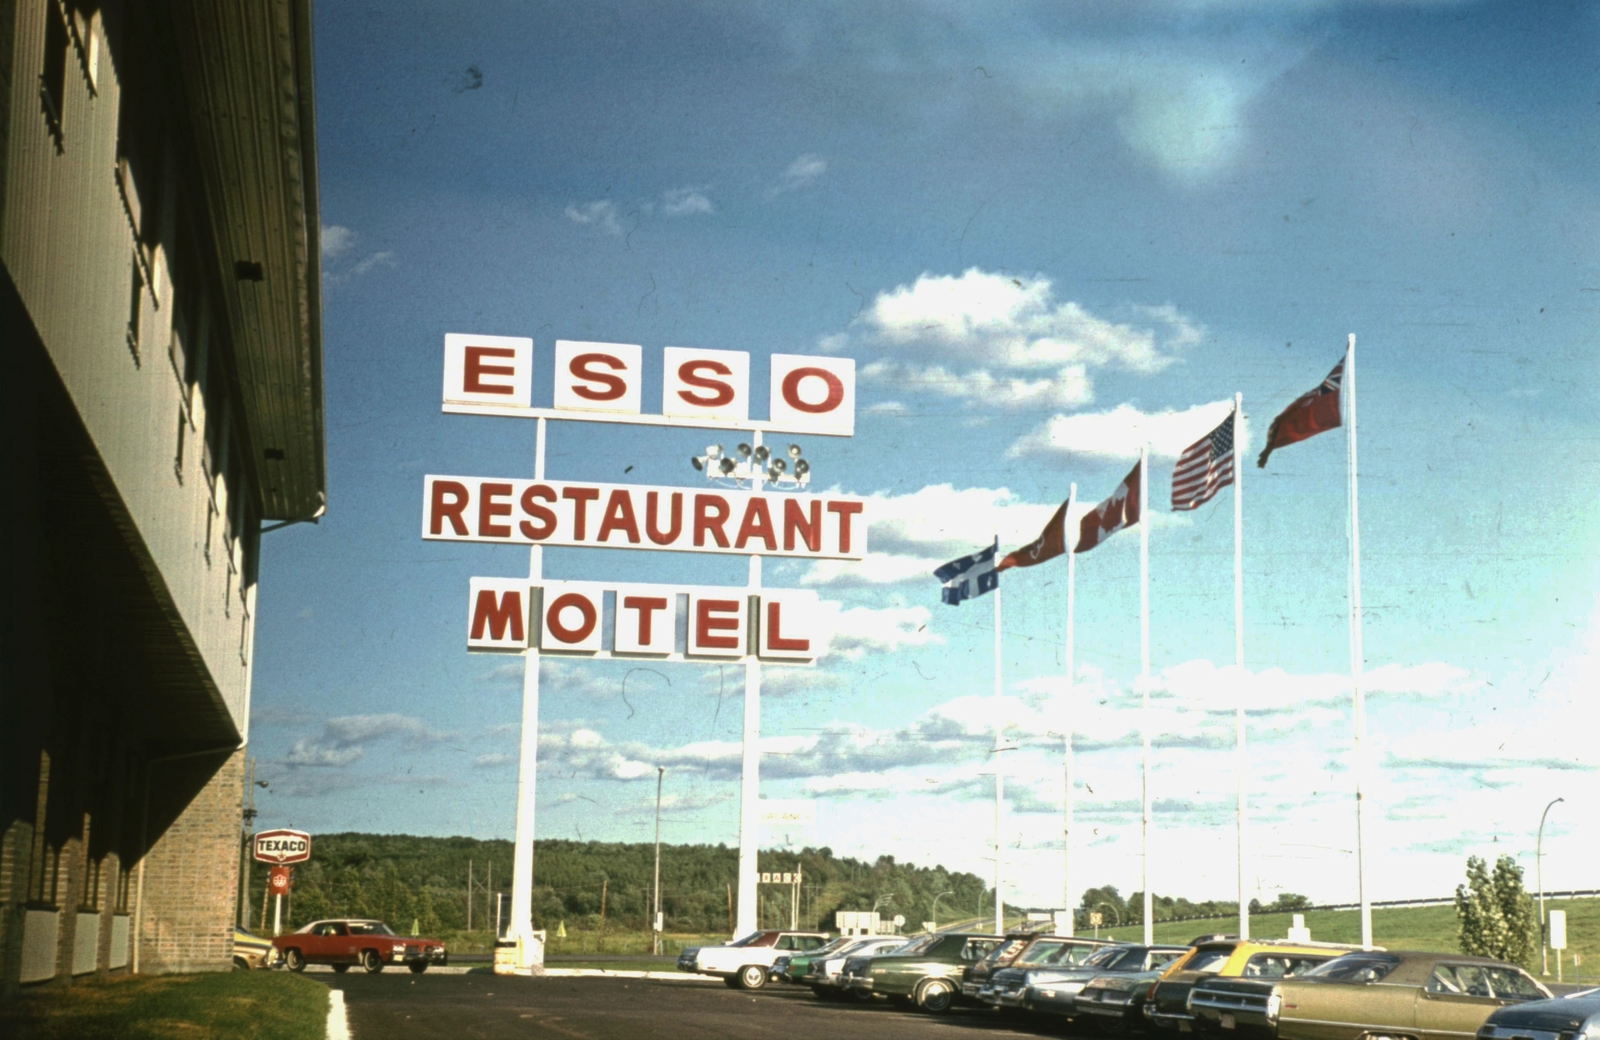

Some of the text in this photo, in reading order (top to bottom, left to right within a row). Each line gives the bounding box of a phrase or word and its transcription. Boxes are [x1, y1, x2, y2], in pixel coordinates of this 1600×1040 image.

[464, 346, 844, 413] ESSO
[430, 480, 863, 552] RESTAURANT
[470, 590, 810, 650] MOTEL
[259, 840, 306, 851] TEXACO
